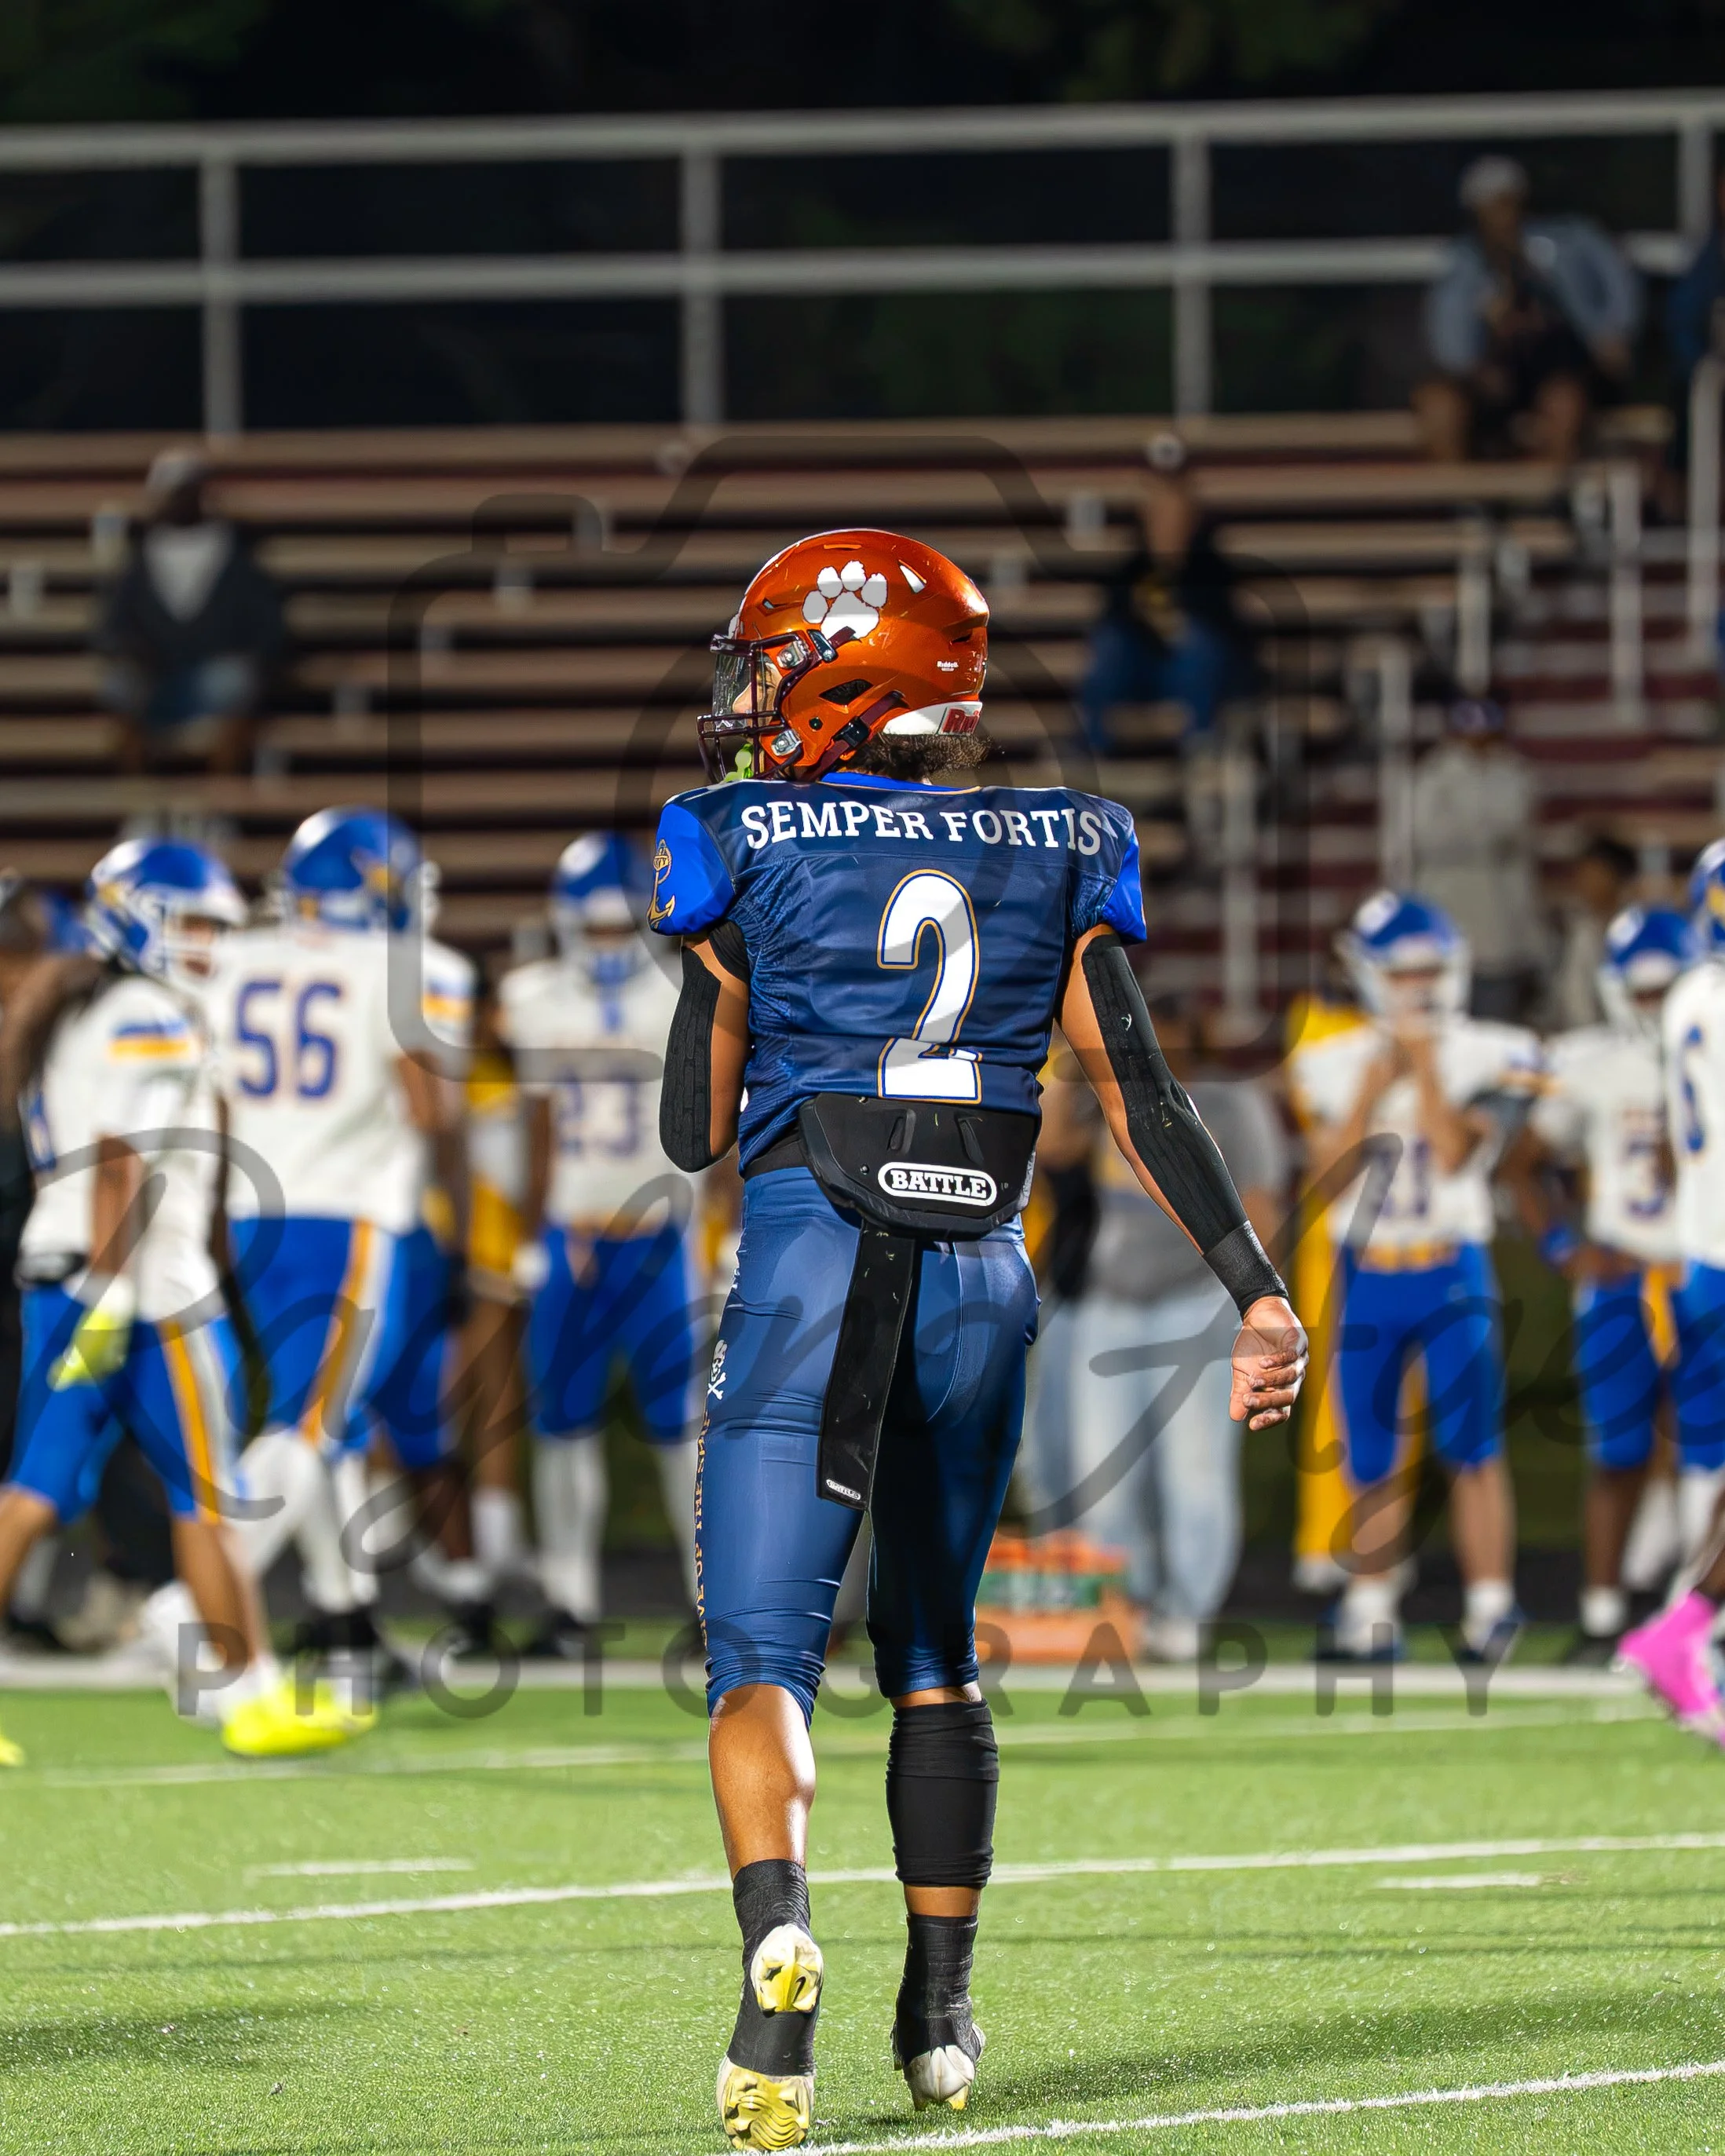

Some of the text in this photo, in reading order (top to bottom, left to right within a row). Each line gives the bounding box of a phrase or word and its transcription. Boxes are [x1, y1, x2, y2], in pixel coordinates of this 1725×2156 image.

[741, 800, 1102, 857] SEMPER FORTIS
[876, 868, 982, 1105] 2
[236, 978, 344, 1099] 56
[890, 1170, 987, 1199] BATTLE
